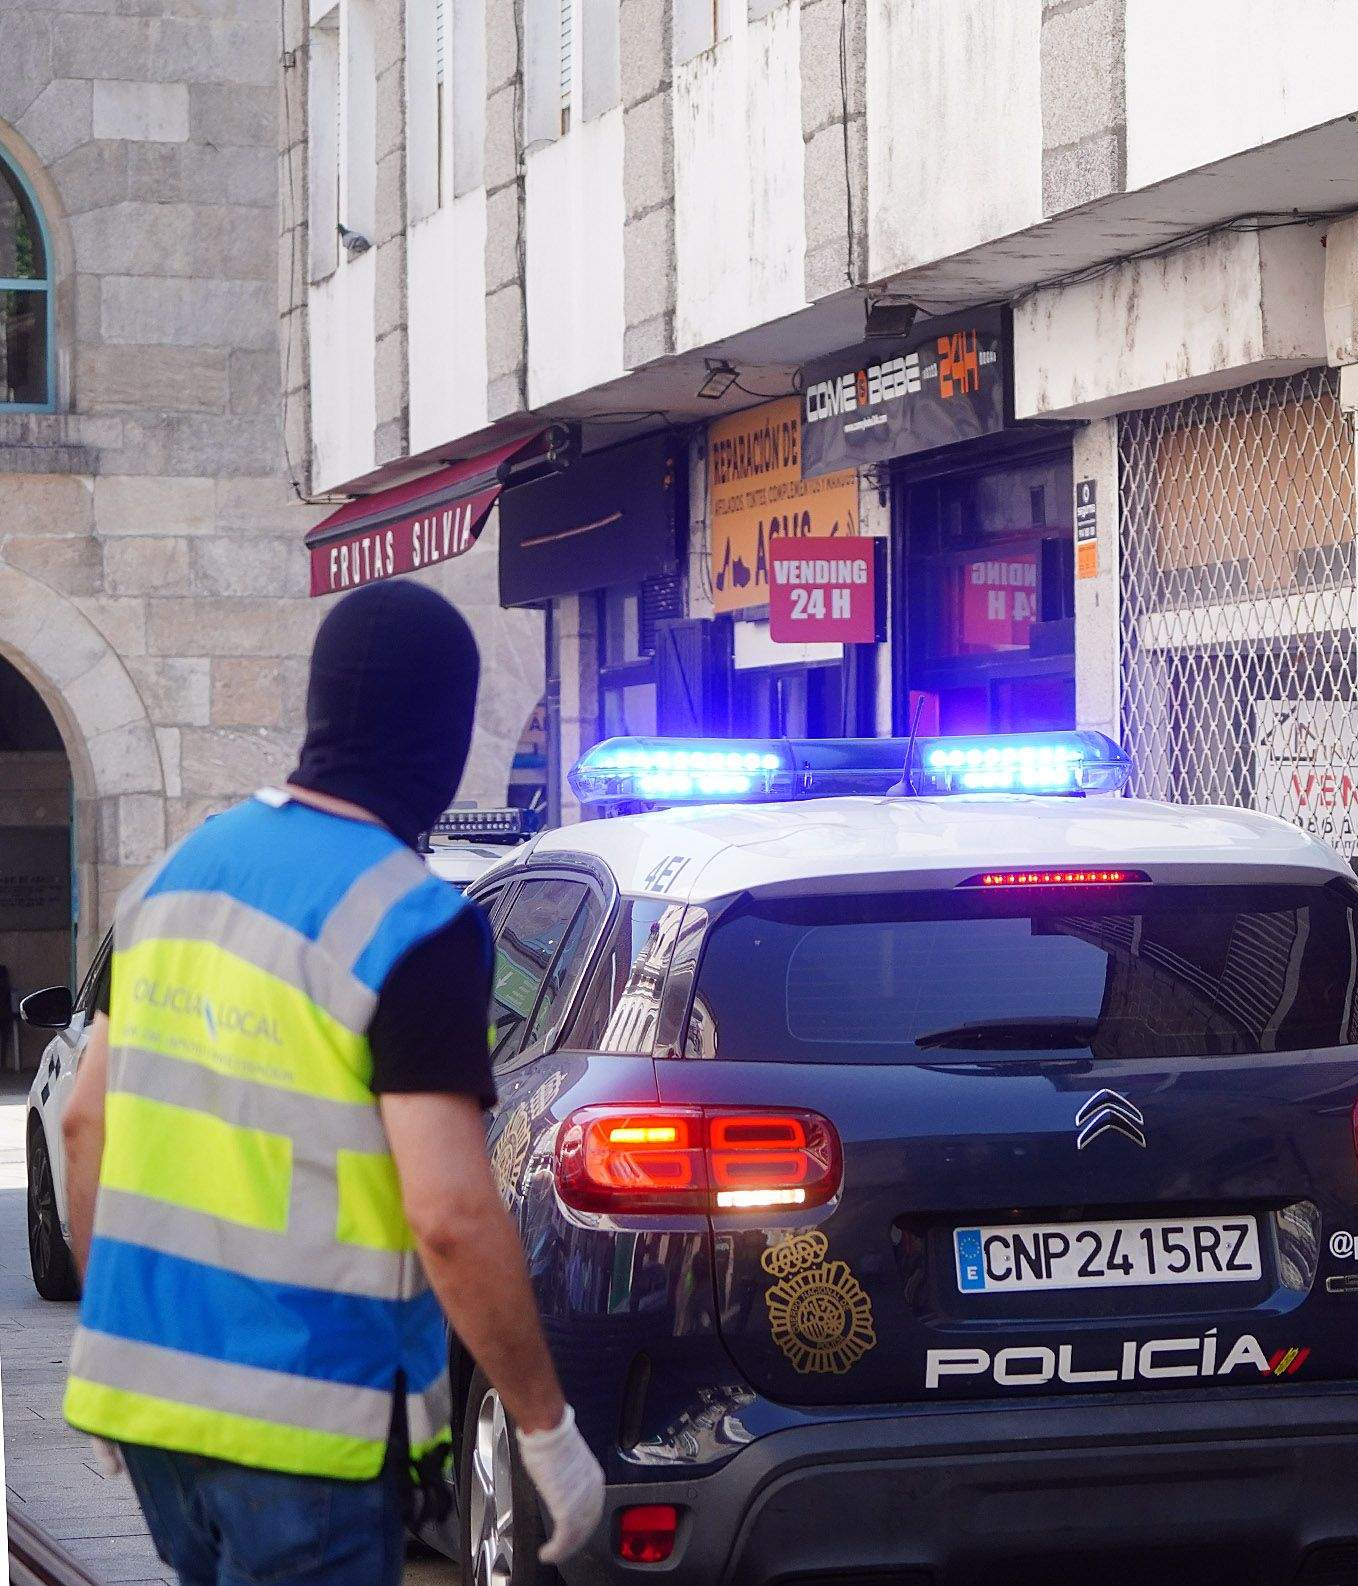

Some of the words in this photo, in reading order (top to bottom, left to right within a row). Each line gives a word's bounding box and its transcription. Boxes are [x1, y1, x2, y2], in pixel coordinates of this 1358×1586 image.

[807, 373, 857, 423] COME
[868, 352, 921, 405] BEBE
[937, 328, 979, 399] 24H
[713, 417, 779, 485] REPARACIÓN
[782, 419, 798, 468] DE
[330, 531, 394, 589] FRUTAS
[412, 504, 472, 567] SILVIA
[773, 560, 868, 584] VENDING
[790, 589, 826, 619] 24
[832, 588, 851, 619] H
[217, 1003, 283, 1046] LOCAL
[967, 1266, 979, 1280] E
[984, 1223, 1253, 1281] CNP2415RZ
[925, 1328, 1271, 1388] POLICÍA
